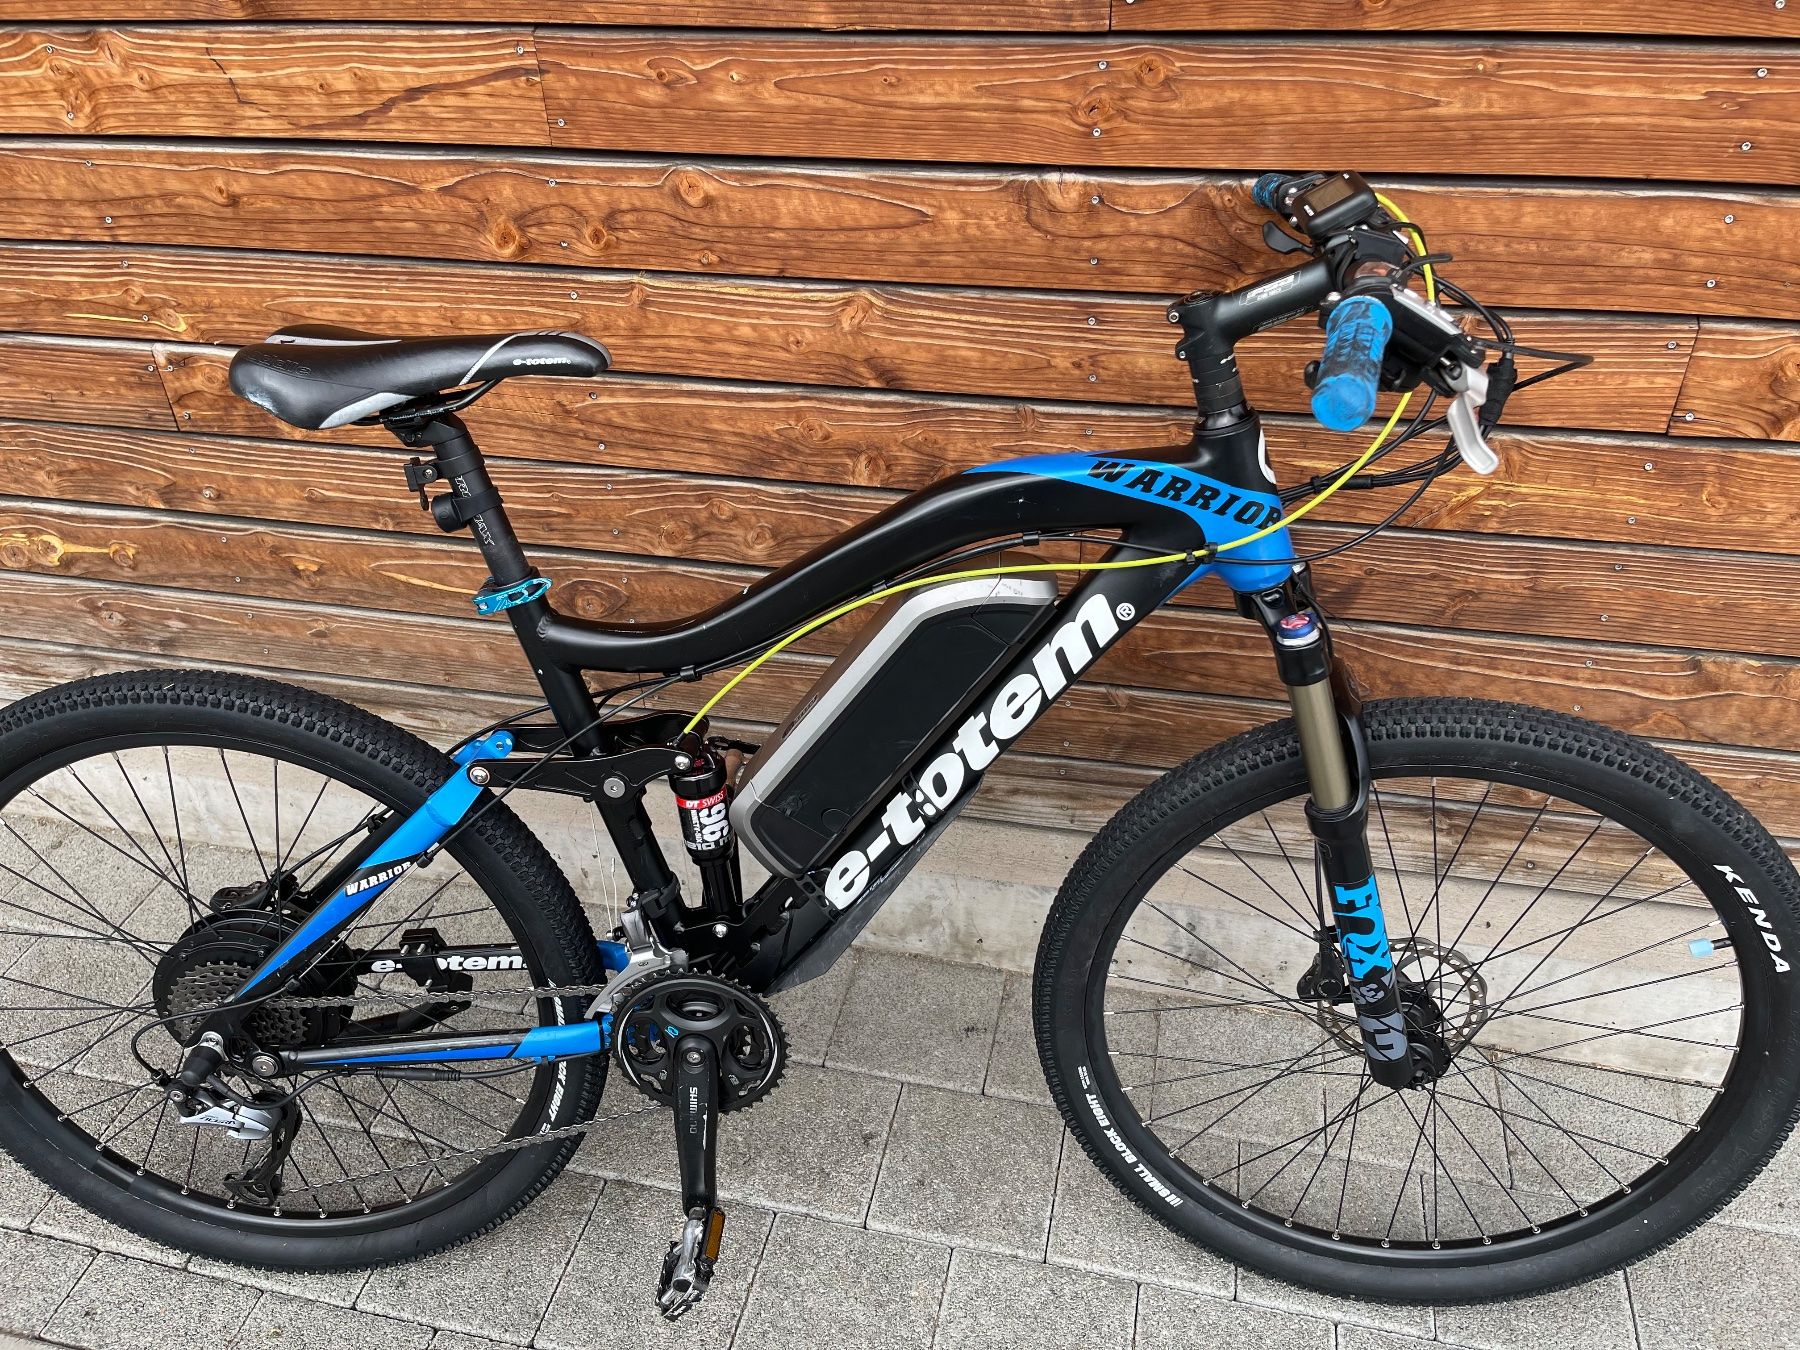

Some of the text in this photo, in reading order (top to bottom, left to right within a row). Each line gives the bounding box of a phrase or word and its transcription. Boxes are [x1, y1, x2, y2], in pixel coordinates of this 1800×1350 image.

[1086, 459, 1282, 533] WARRIOR
[686, 790, 724, 808] DT SWISS
[346, 861, 412, 896] WARRIOR
[1712, 864, 1791, 973] KENDA
[1333, 873, 1393, 979] FOX
[1085, 1093, 1172, 1197] SMALL BLOCK EIGHT
